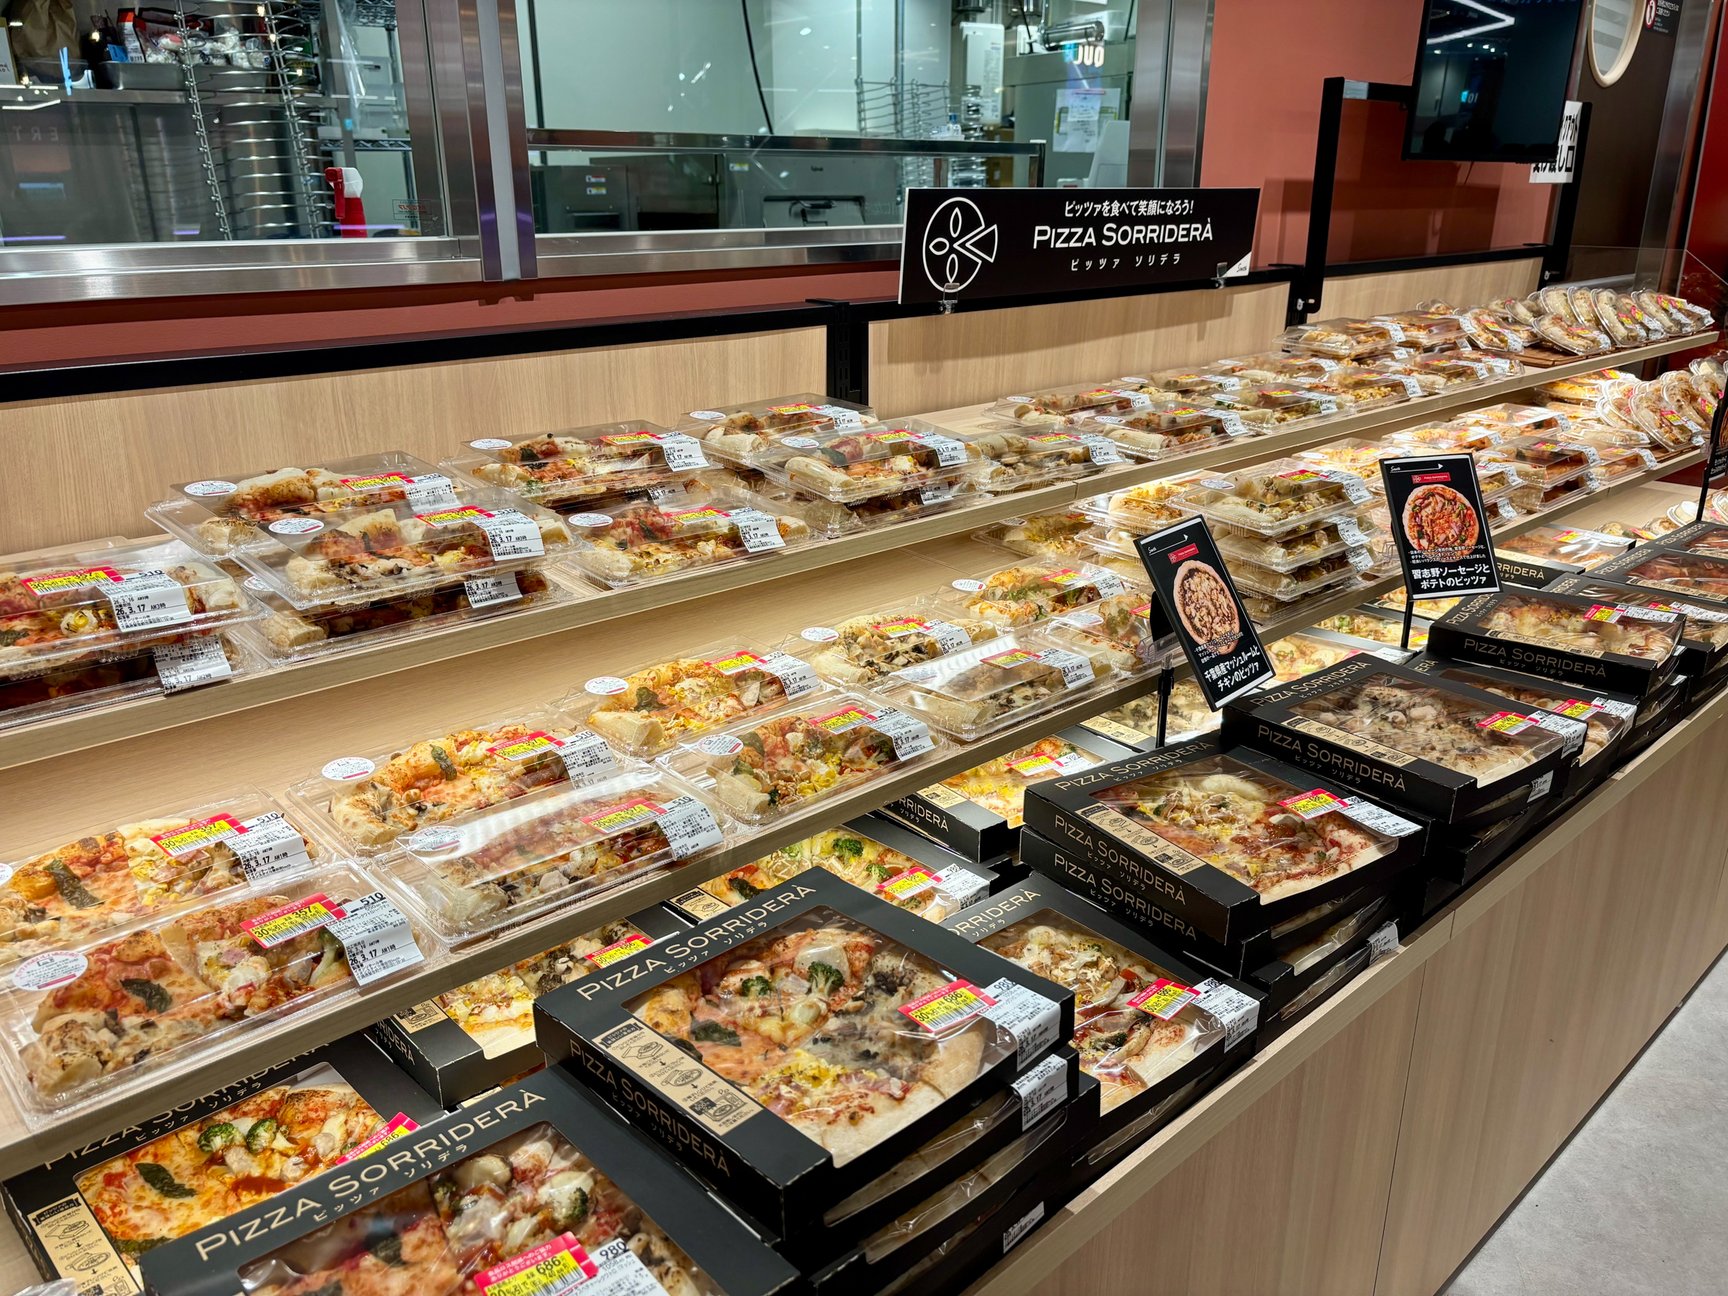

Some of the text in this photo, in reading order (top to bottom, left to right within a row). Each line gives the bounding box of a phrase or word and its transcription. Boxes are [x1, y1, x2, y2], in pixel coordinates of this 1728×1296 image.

[1033, 217, 1214, 249] PIZZA SORRIDERÀ
[1071, 253, 1182, 271] ピッツァ ソリデラ
[1411, 563, 1491, 580] 習志野ソーセージと
[1420, 576, 1487, 590] ポテトのピッツァ
[1204, 645, 1261, 683] 千葉県産マッシュルームと
[1217, 661, 1260, 692] チキンのピッツァ
[1463, 638, 1607, 678] PIZZA SORRIDERÀ
[1258, 724, 1406, 792] PIZZA SORRIDERÀ
[1055, 772, 1113, 791] PIZZA
[1054, 853, 1097, 888] PIZZA
[1055, 814, 1186, 906] PIZZA SORRIDERÀ
[1087, 851, 1147, 891] ピッツァ ソリデラ
[360, 892, 386, 906] 510
[1090, 888, 1154, 927] ピッツァ ソリデラ
[350, 949, 378, 966] 26.3.17
[576, 884, 817, 1001] PIZZA SORRIDERÀ
[663, 920, 768, 974] ピッツァ ソリデラ
[134, 1081, 262, 1142] ピッツァ ソリデラ
[569, 1038, 731, 1177] PIZZA SORRIDERÀ
[194, 1089, 547, 1262] PIZZA SORRIDERÀ
[313, 1143, 469, 1222] ピッツァ ソリデラ
[599, 1240, 629, 1261] 980
